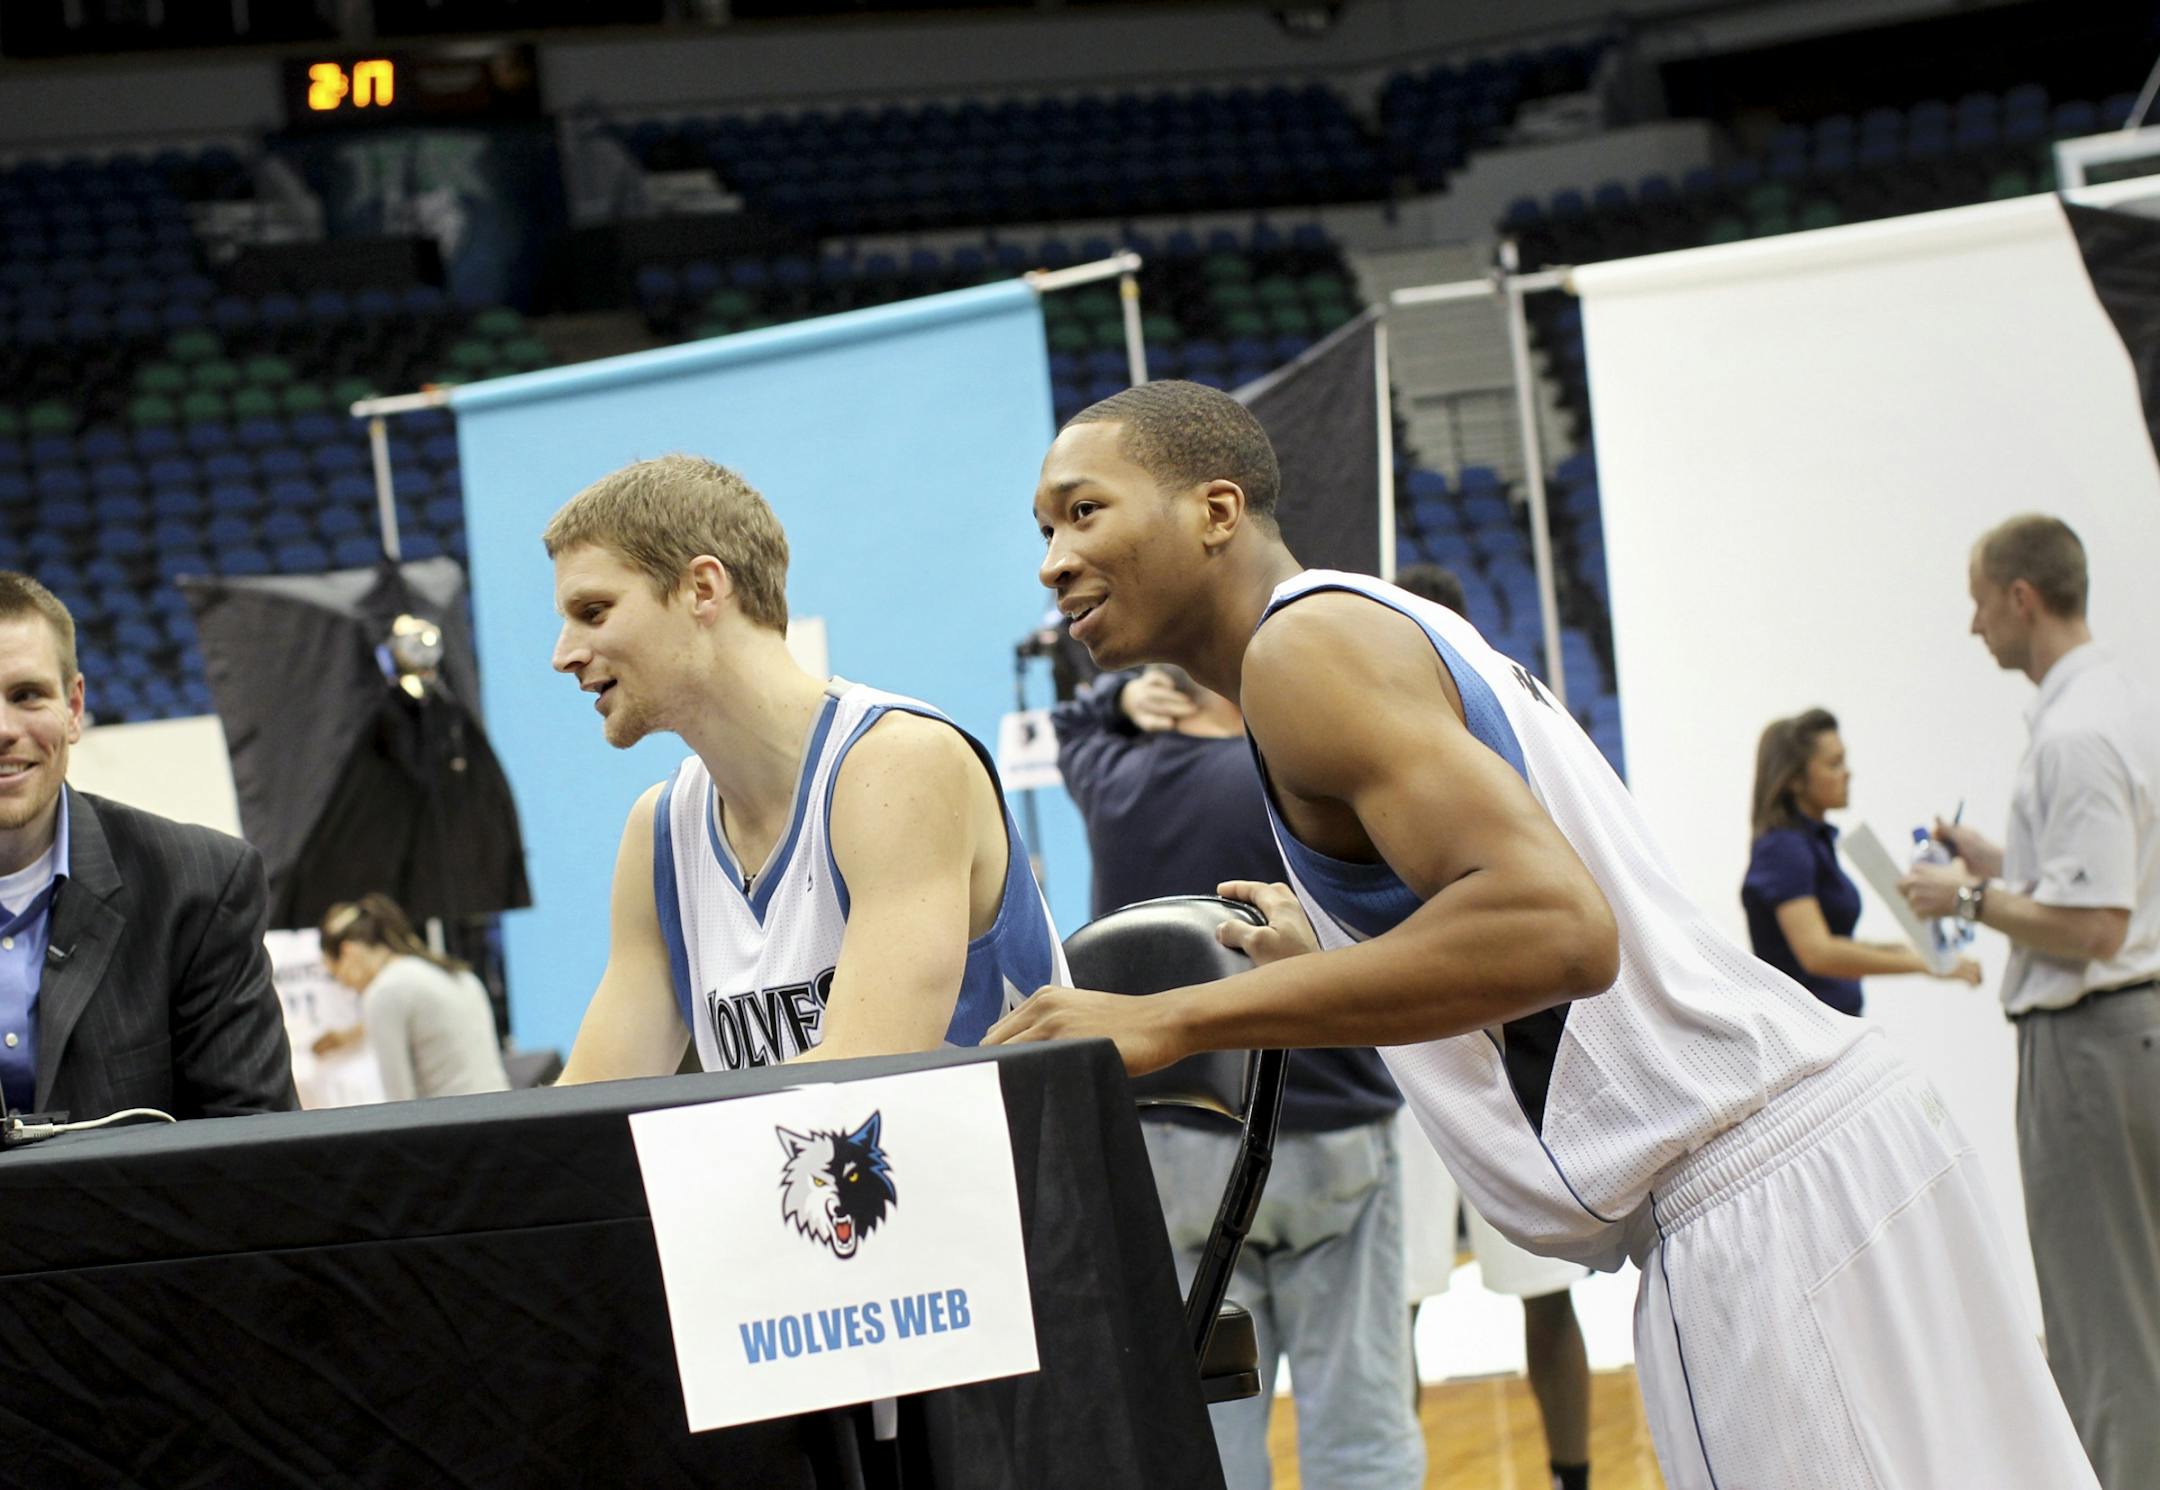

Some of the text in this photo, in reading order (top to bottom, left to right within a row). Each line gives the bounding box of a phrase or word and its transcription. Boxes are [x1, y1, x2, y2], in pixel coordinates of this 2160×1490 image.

[706, 966, 837, 1070] OLVE
[739, 1288, 971, 1364] WOLVES WEB
